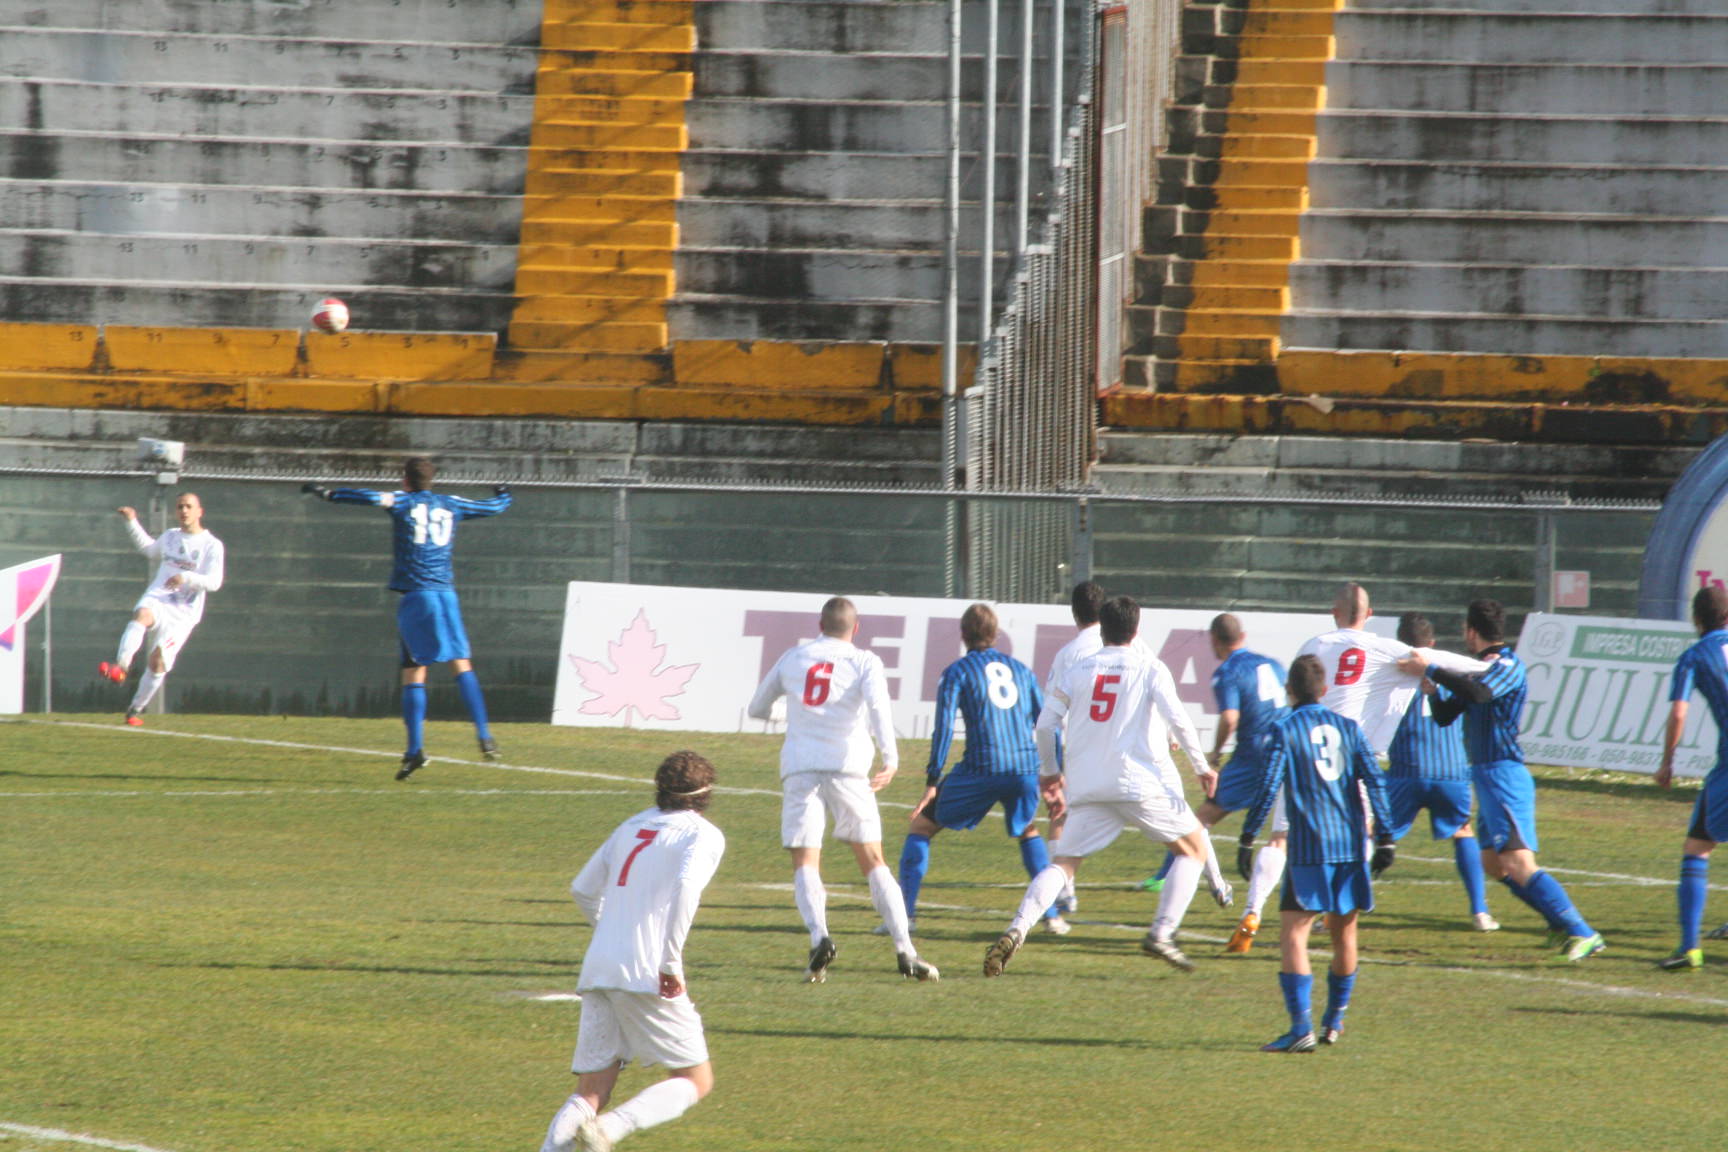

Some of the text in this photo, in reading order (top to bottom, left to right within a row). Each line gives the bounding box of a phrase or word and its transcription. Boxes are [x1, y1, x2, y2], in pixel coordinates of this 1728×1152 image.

[327, 95, 335, 106] 7
[307, 245, 315, 256] 7
[272, 334, 281, 345] 7
[341, 335, 352, 348] 5
[404, 336, 413, 348] 3
[803, 662, 834, 707] 6
[985, 661, 1018, 709] 8
[1334, 648, 1366, 685] 9
[1089, 674, 1121, 722] 5
[1519, 661, 1715, 750] GIULI
[1311, 724, 1345, 781] 3
[617, 829, 659, 887] 7
